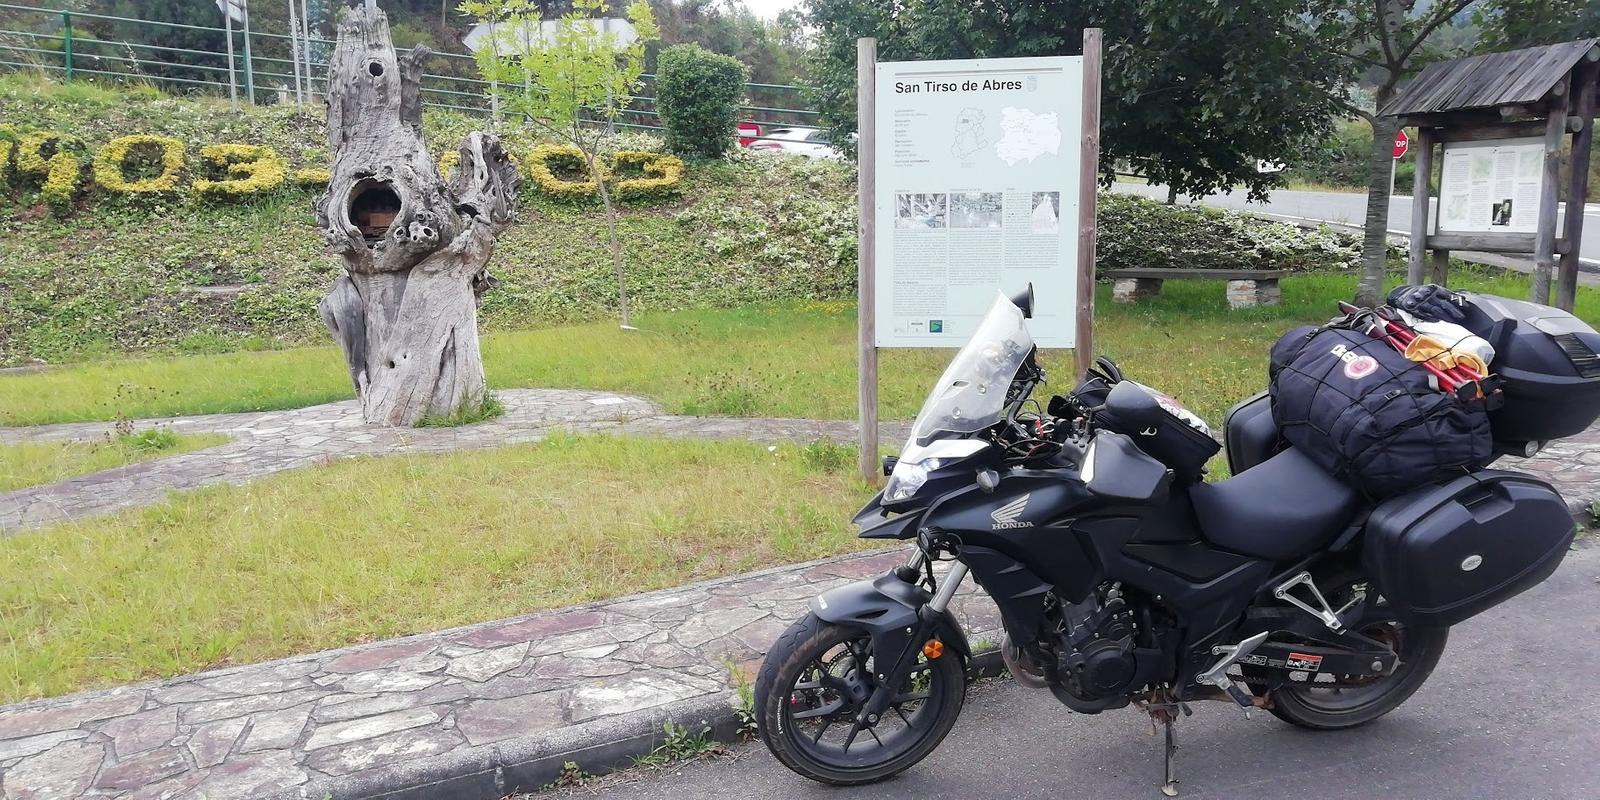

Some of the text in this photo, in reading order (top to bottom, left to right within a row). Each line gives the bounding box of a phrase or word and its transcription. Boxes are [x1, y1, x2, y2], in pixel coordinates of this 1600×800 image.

[895, 79, 1022, 94] San Tirso de Abres
[1395, 140, 1406, 148] OP
[991, 521, 1034, 530] HONDA
